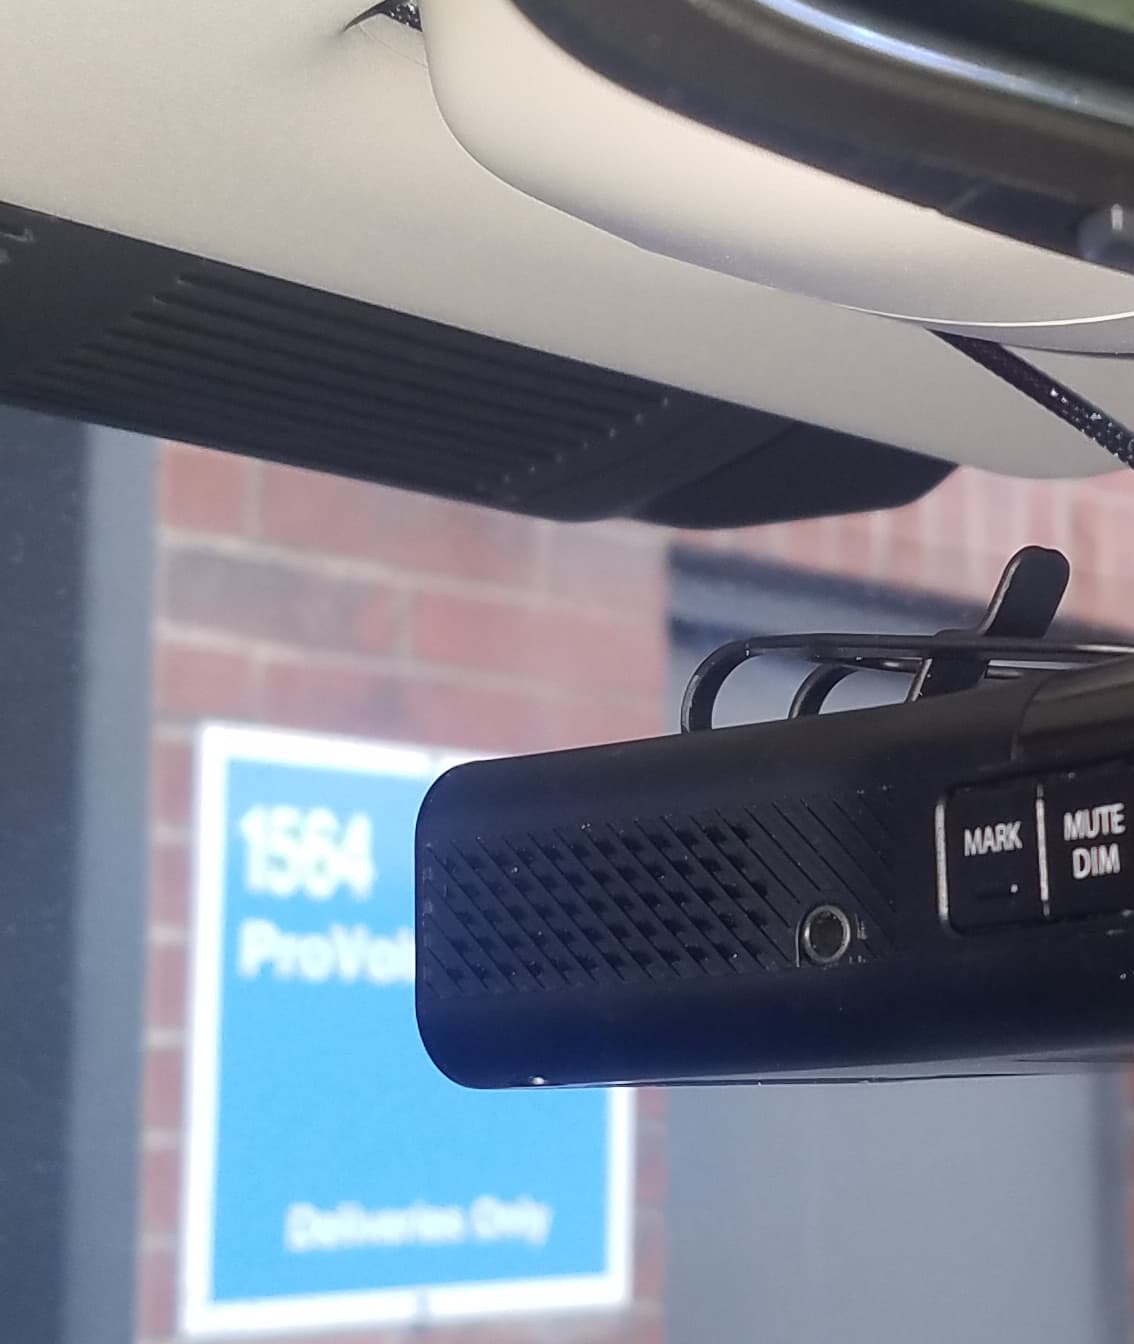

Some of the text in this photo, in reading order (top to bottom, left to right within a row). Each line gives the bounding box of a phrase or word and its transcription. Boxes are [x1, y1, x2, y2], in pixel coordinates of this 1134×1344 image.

[964, 821, 1023, 856] MARK
[1063, 803, 1126, 841] MUTE
[1072, 843, 1121, 879] DIM
[470, 1195, 552, 1244] Only
